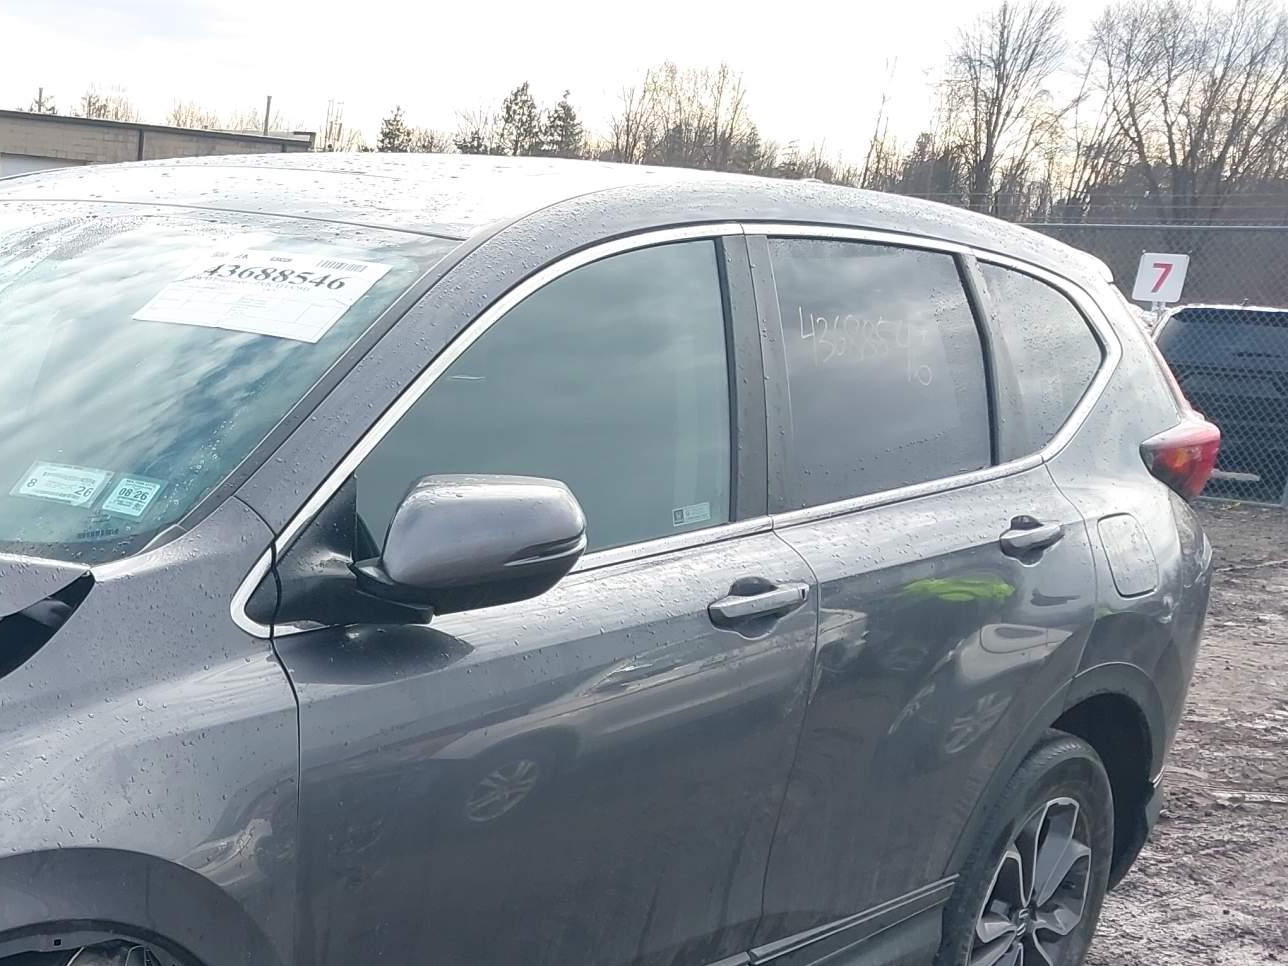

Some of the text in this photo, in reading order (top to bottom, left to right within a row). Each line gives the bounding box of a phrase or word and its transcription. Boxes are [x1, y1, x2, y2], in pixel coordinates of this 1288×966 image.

[202, 262, 352, 290] 43688546
[1150, 262, 1174, 294] 7
[26, 477, 38, 488] 8
[73, 485, 94, 498] 26
